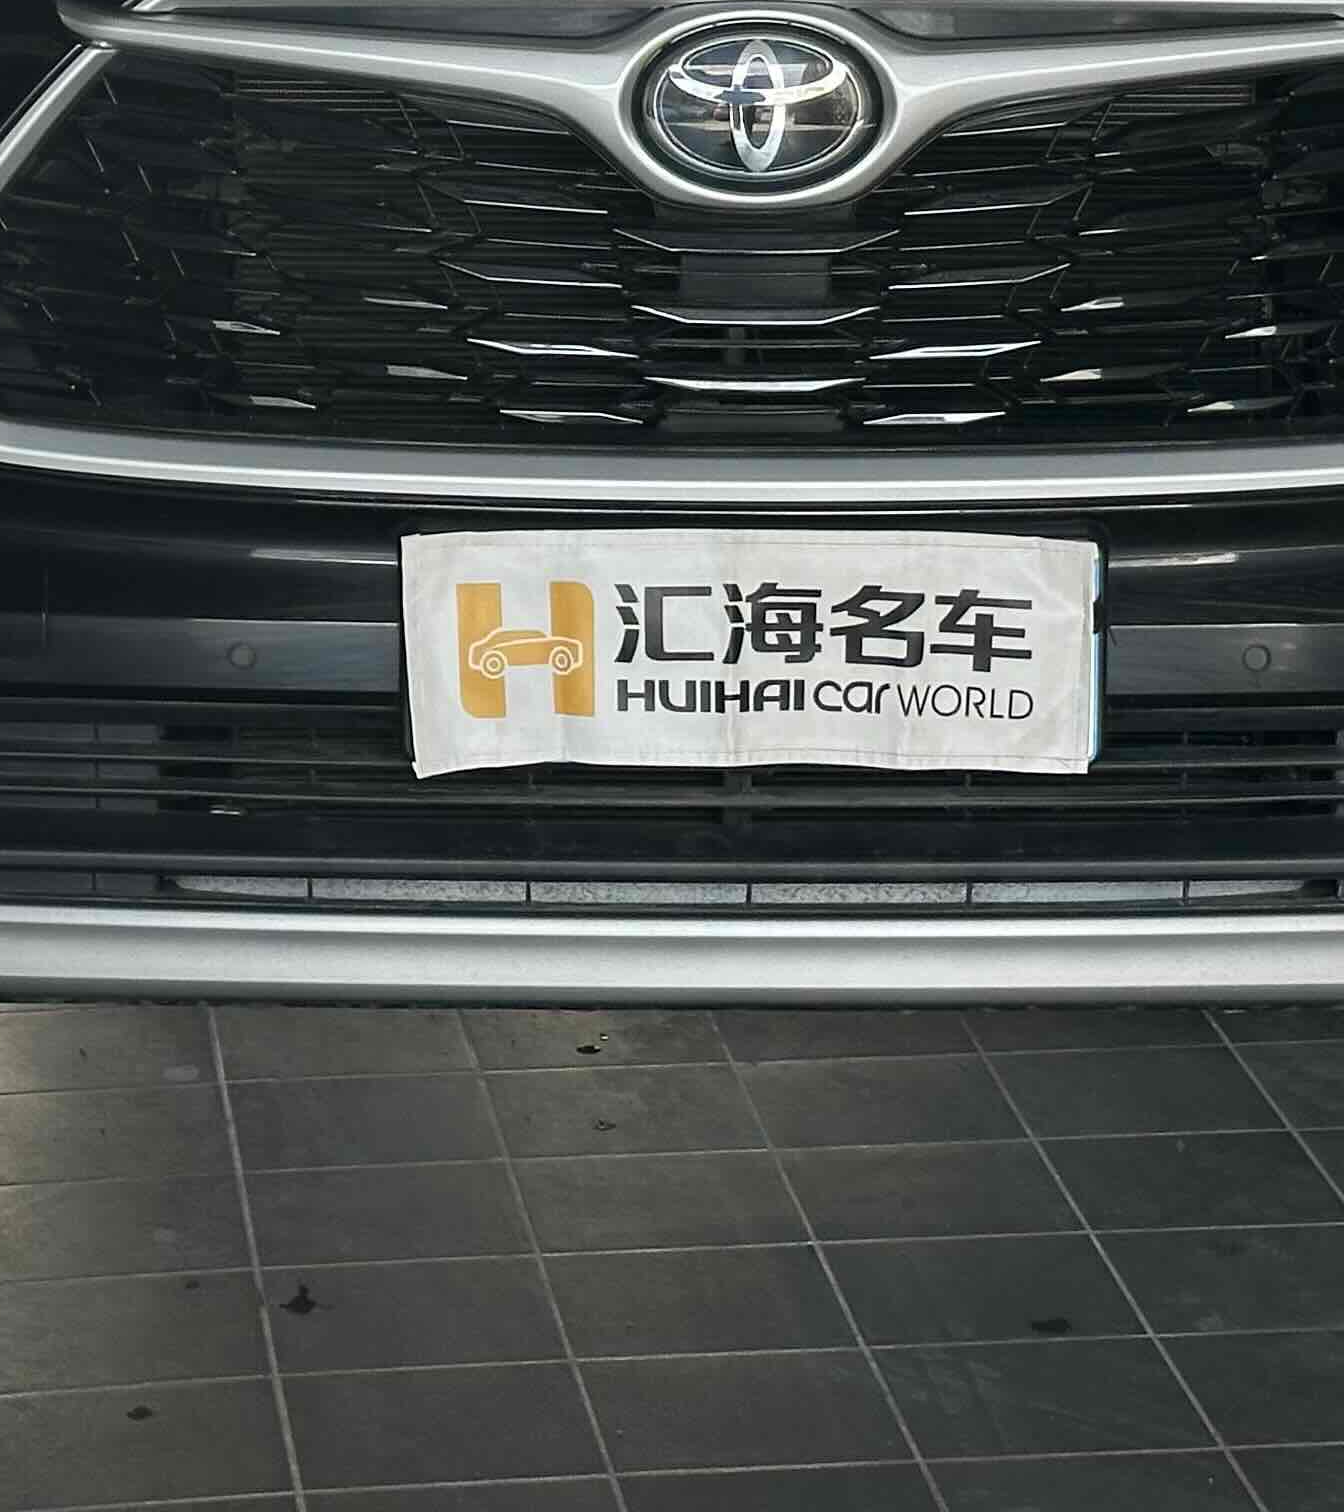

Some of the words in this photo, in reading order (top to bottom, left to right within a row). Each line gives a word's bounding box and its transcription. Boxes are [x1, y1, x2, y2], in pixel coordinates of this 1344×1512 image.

[614, 583, 1033, 672] 汇海名车
[617, 679, 805, 713] HUIHAI
[813, 679, 890, 714] car
[897, 684, 1033, 719] WORLD
